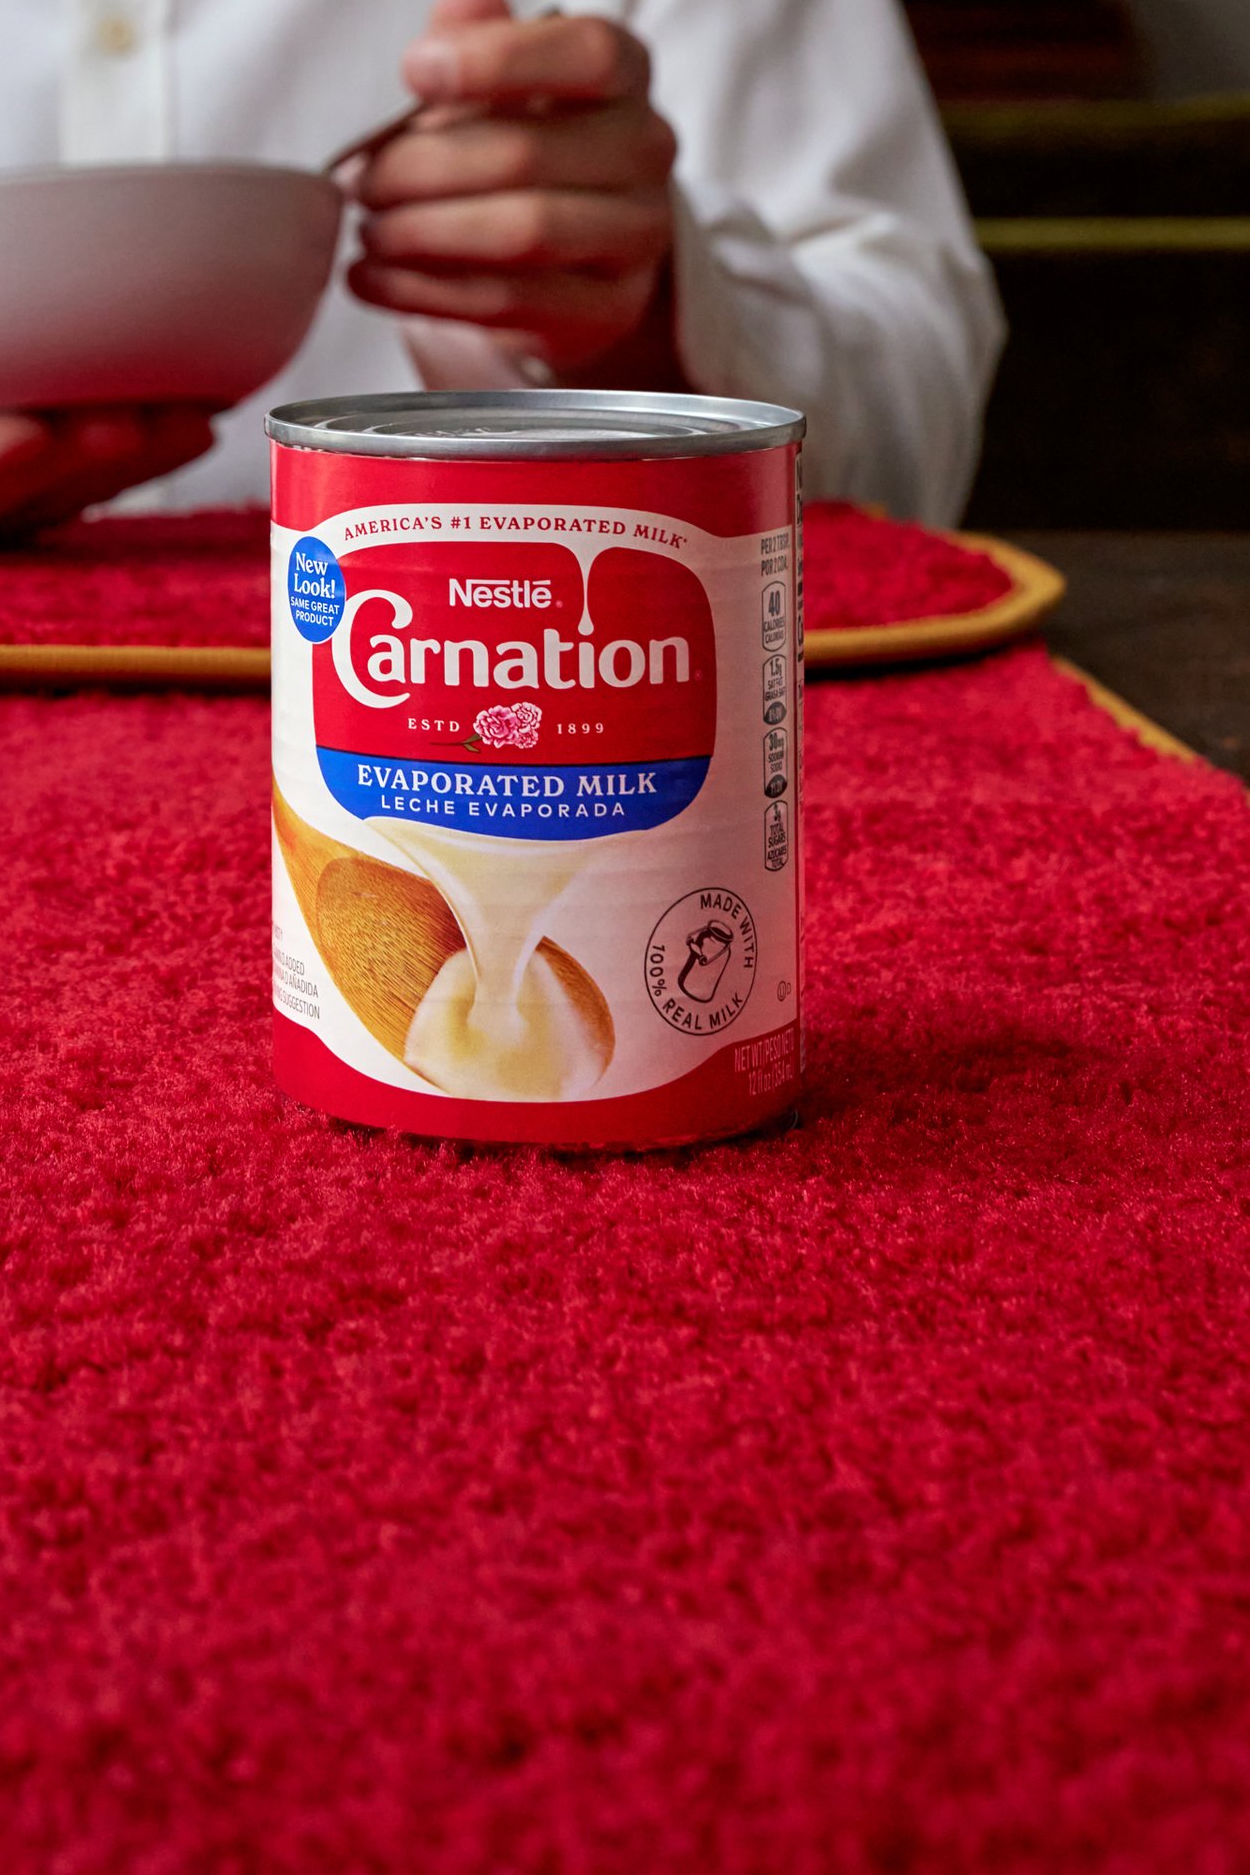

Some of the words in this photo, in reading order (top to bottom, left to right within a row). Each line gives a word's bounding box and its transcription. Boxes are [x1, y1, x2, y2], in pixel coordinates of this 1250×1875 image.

[344, 516, 443, 541] AMERICA'S
[451, 516, 472, 529] #1
[479, 516, 626, 535] EVAPORATED
[295, 552, 328, 575] New
[293, 573, 336, 599] Look!
[449, 578, 552, 609] Nestlé
[290, 596, 310, 610] SAME
[311, 600, 340, 615] GREAT
[768, 590, 780, 616] 40
[295, 610, 334, 626] PRODUCT
[331, 589, 690, 709] Carnation
[408, 717, 460, 733] ESTD
[557, 722, 604, 735] 1899
[357, 764, 565, 797] EVAPORATED
[576, 772, 658, 797] MILK
[381, 794, 456, 815] LECHE
[469, 801, 625, 818] EVAPORADA
[700, 893, 742, 919] MADE
[739, 916, 755, 968] WITH
[286, 956, 305, 976] ADDED
[289, 973, 319, 998] AÑADIDA
[649, 944, 667, 997] 100%
[662, 997, 703, 1030] REAL
[709, 992, 744, 1030] MILK
[282, 990, 321, 1020] SUGGESTION
